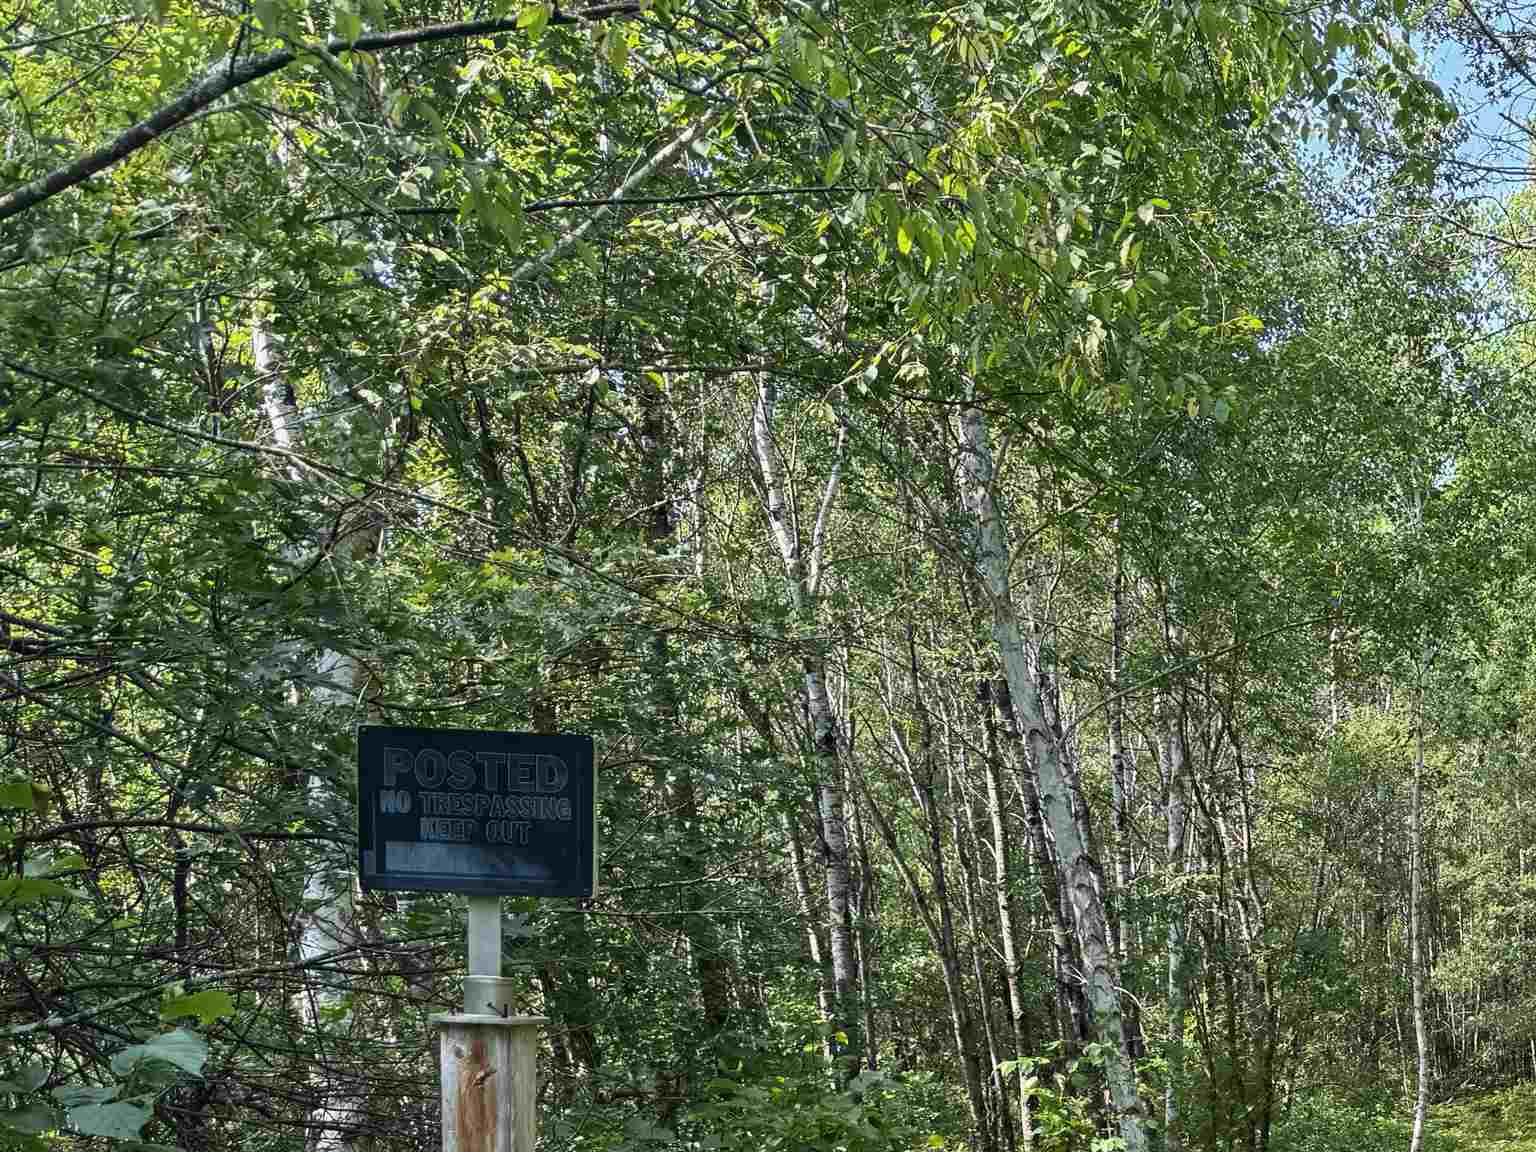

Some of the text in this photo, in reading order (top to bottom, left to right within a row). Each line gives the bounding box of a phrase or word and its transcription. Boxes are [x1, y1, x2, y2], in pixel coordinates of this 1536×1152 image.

[383, 746, 569, 793] POSTED
[380, 790, 572, 820] NO TRESPASSING
[486, 820, 532, 844] OUT
